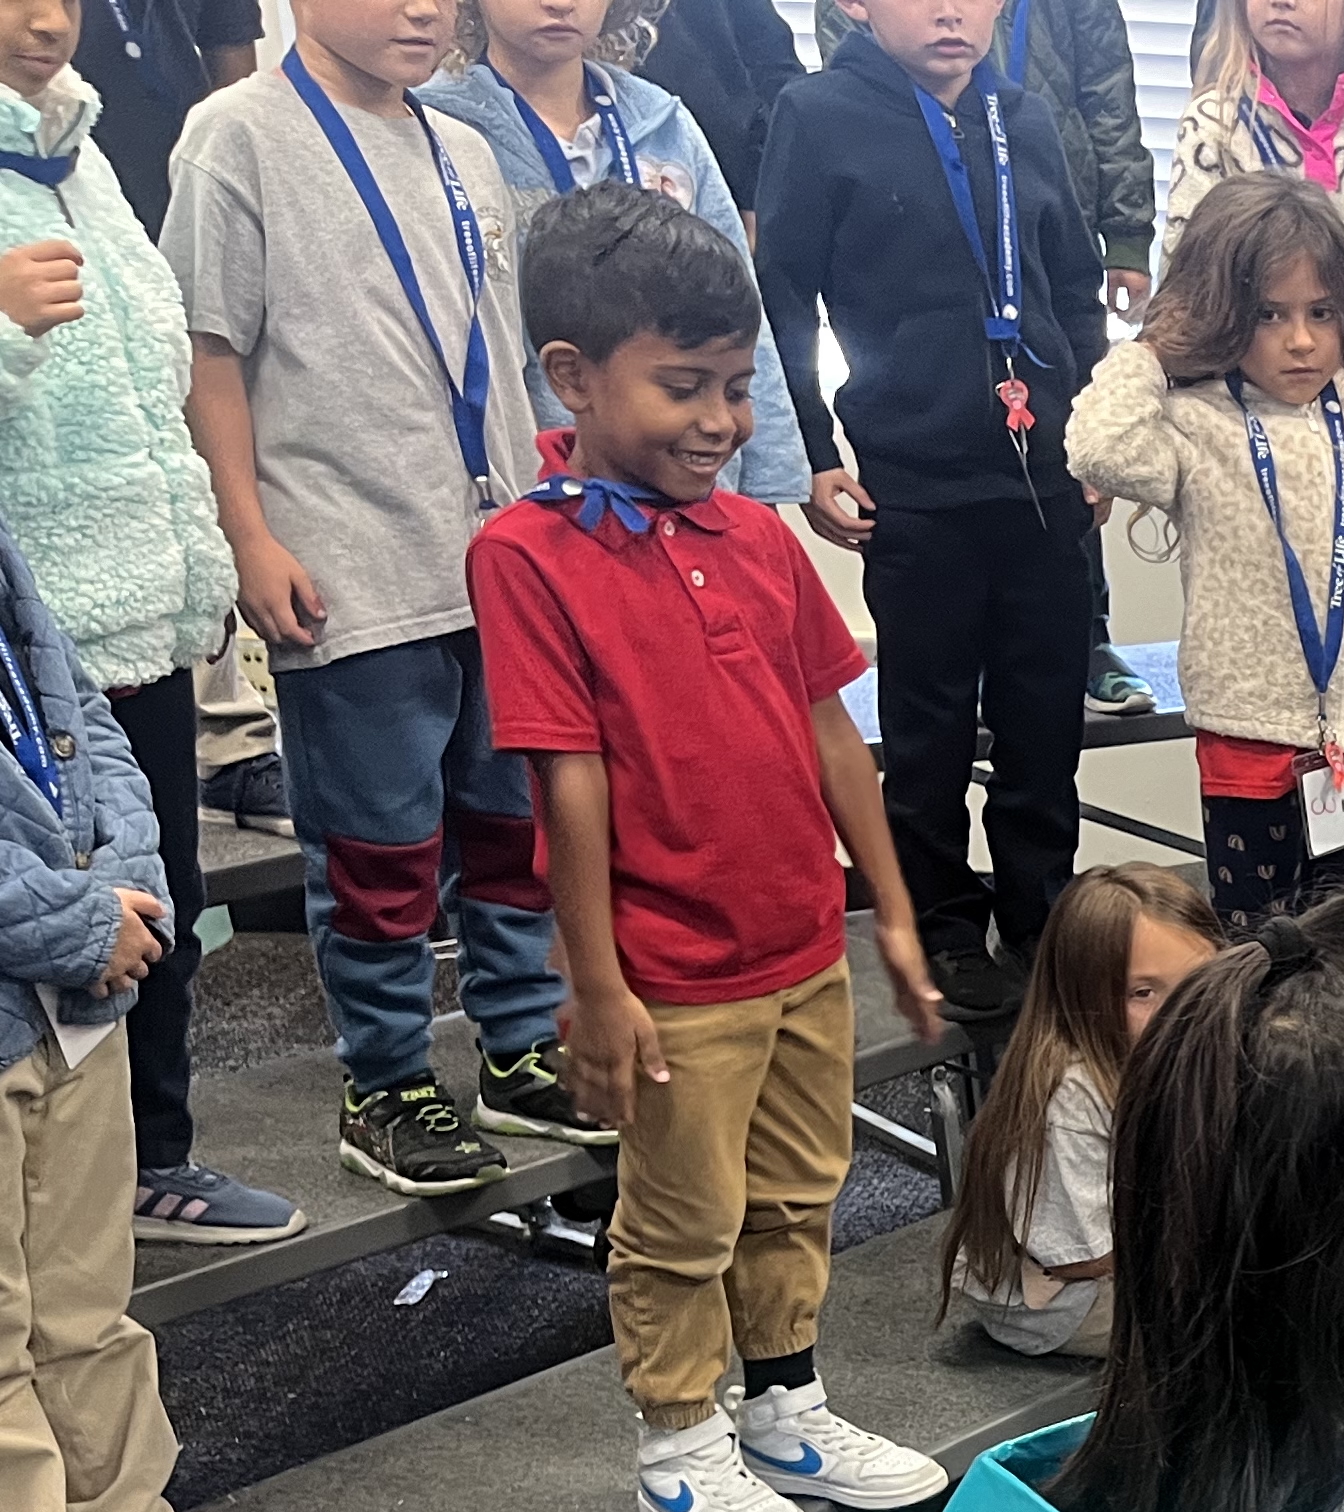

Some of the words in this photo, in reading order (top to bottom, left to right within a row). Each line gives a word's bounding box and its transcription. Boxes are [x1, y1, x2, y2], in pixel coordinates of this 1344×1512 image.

[996, 133, 1009, 166] Life
[451, 179, 469, 212] Life
[1330, 576, 1344, 610] Tree
